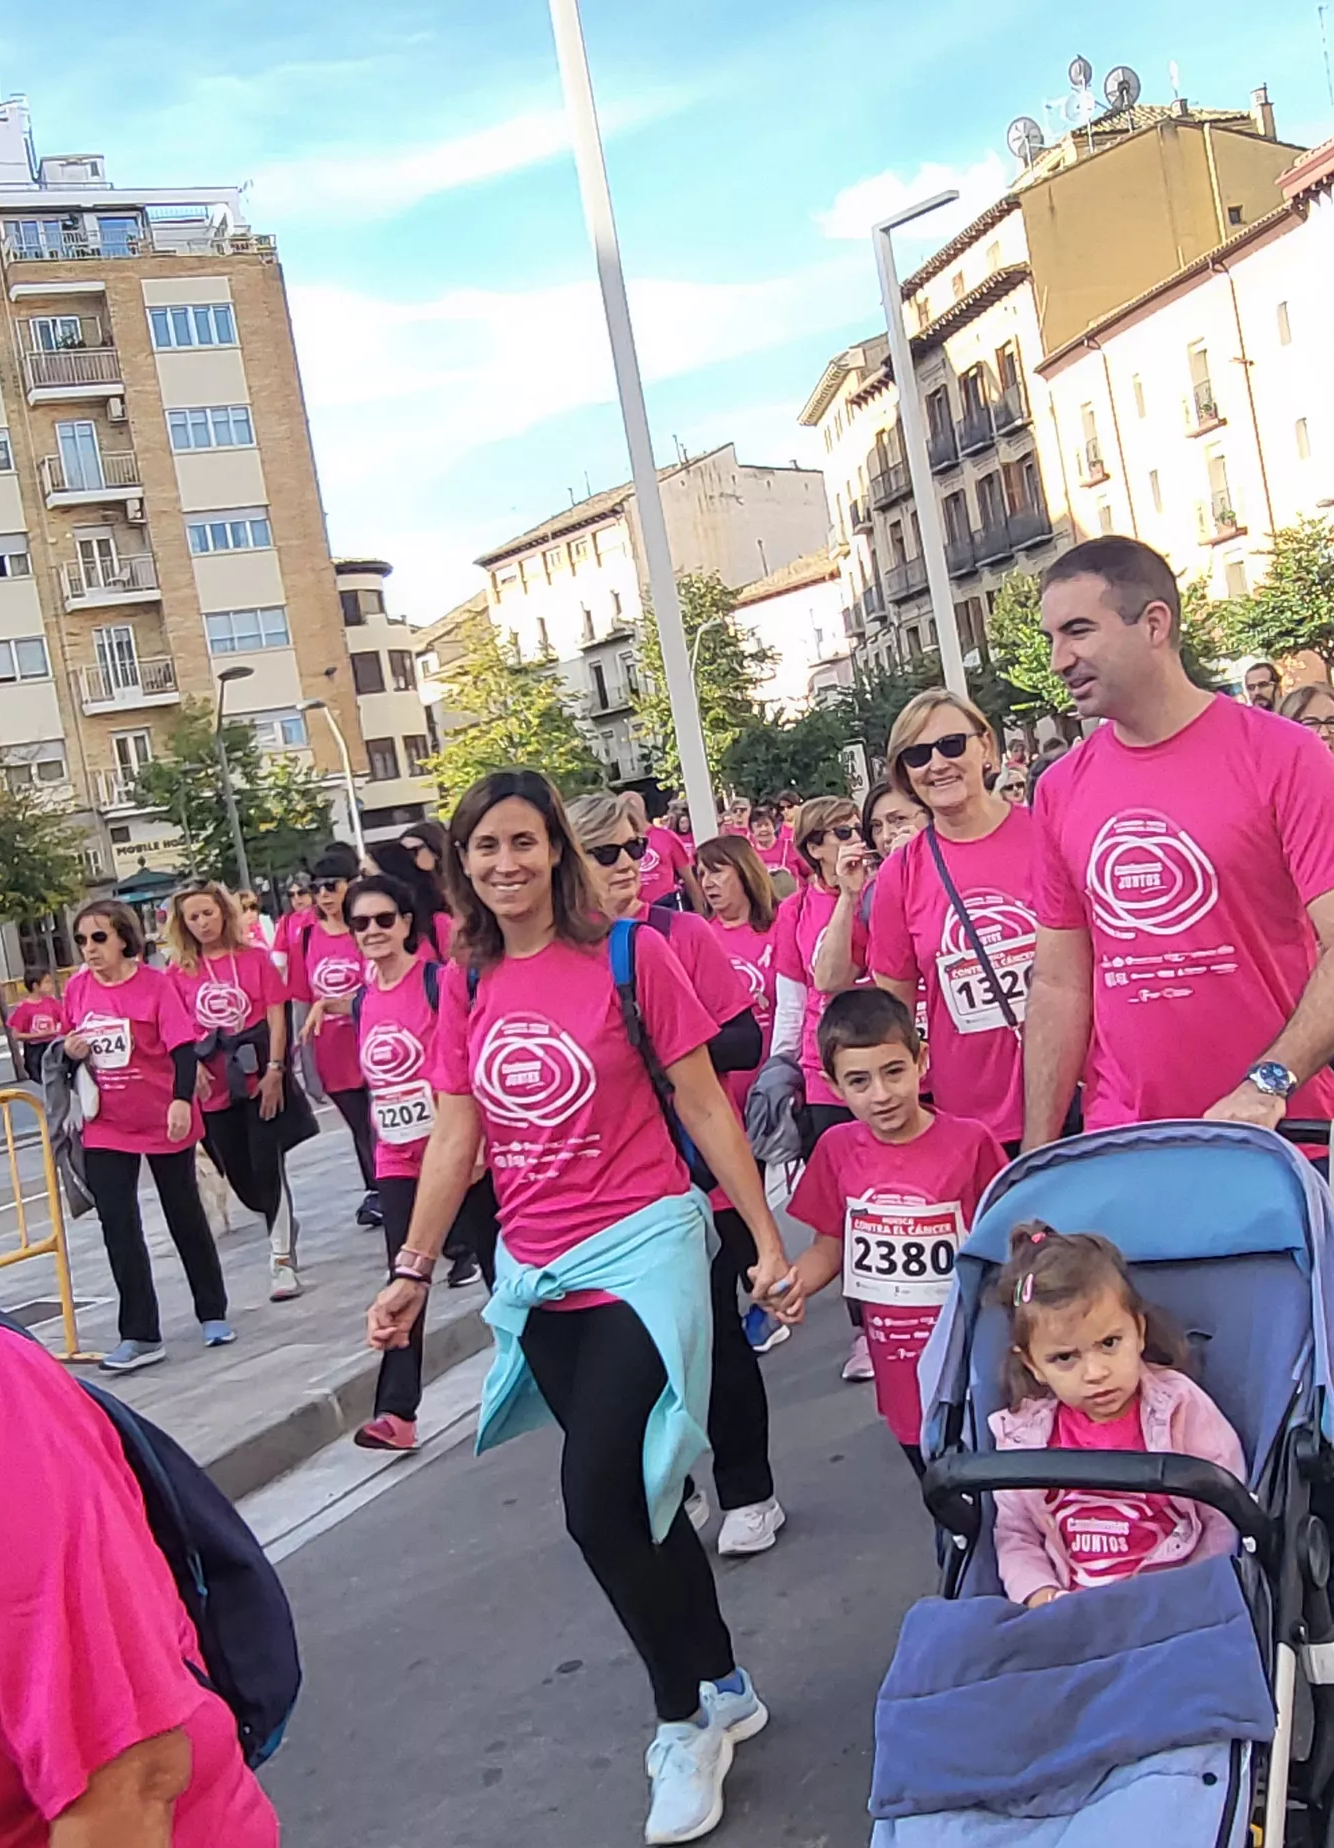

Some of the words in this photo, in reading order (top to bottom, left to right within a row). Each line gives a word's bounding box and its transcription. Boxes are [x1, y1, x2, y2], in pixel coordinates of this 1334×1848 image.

[116, 841, 160, 856] MOBILE
[854, 1218, 892, 1235] CONTRA
[893, 1225, 906, 1236] EL
[854, 1236, 955, 1277] 2380
[1071, 1533, 1129, 1553] JUNTOS
